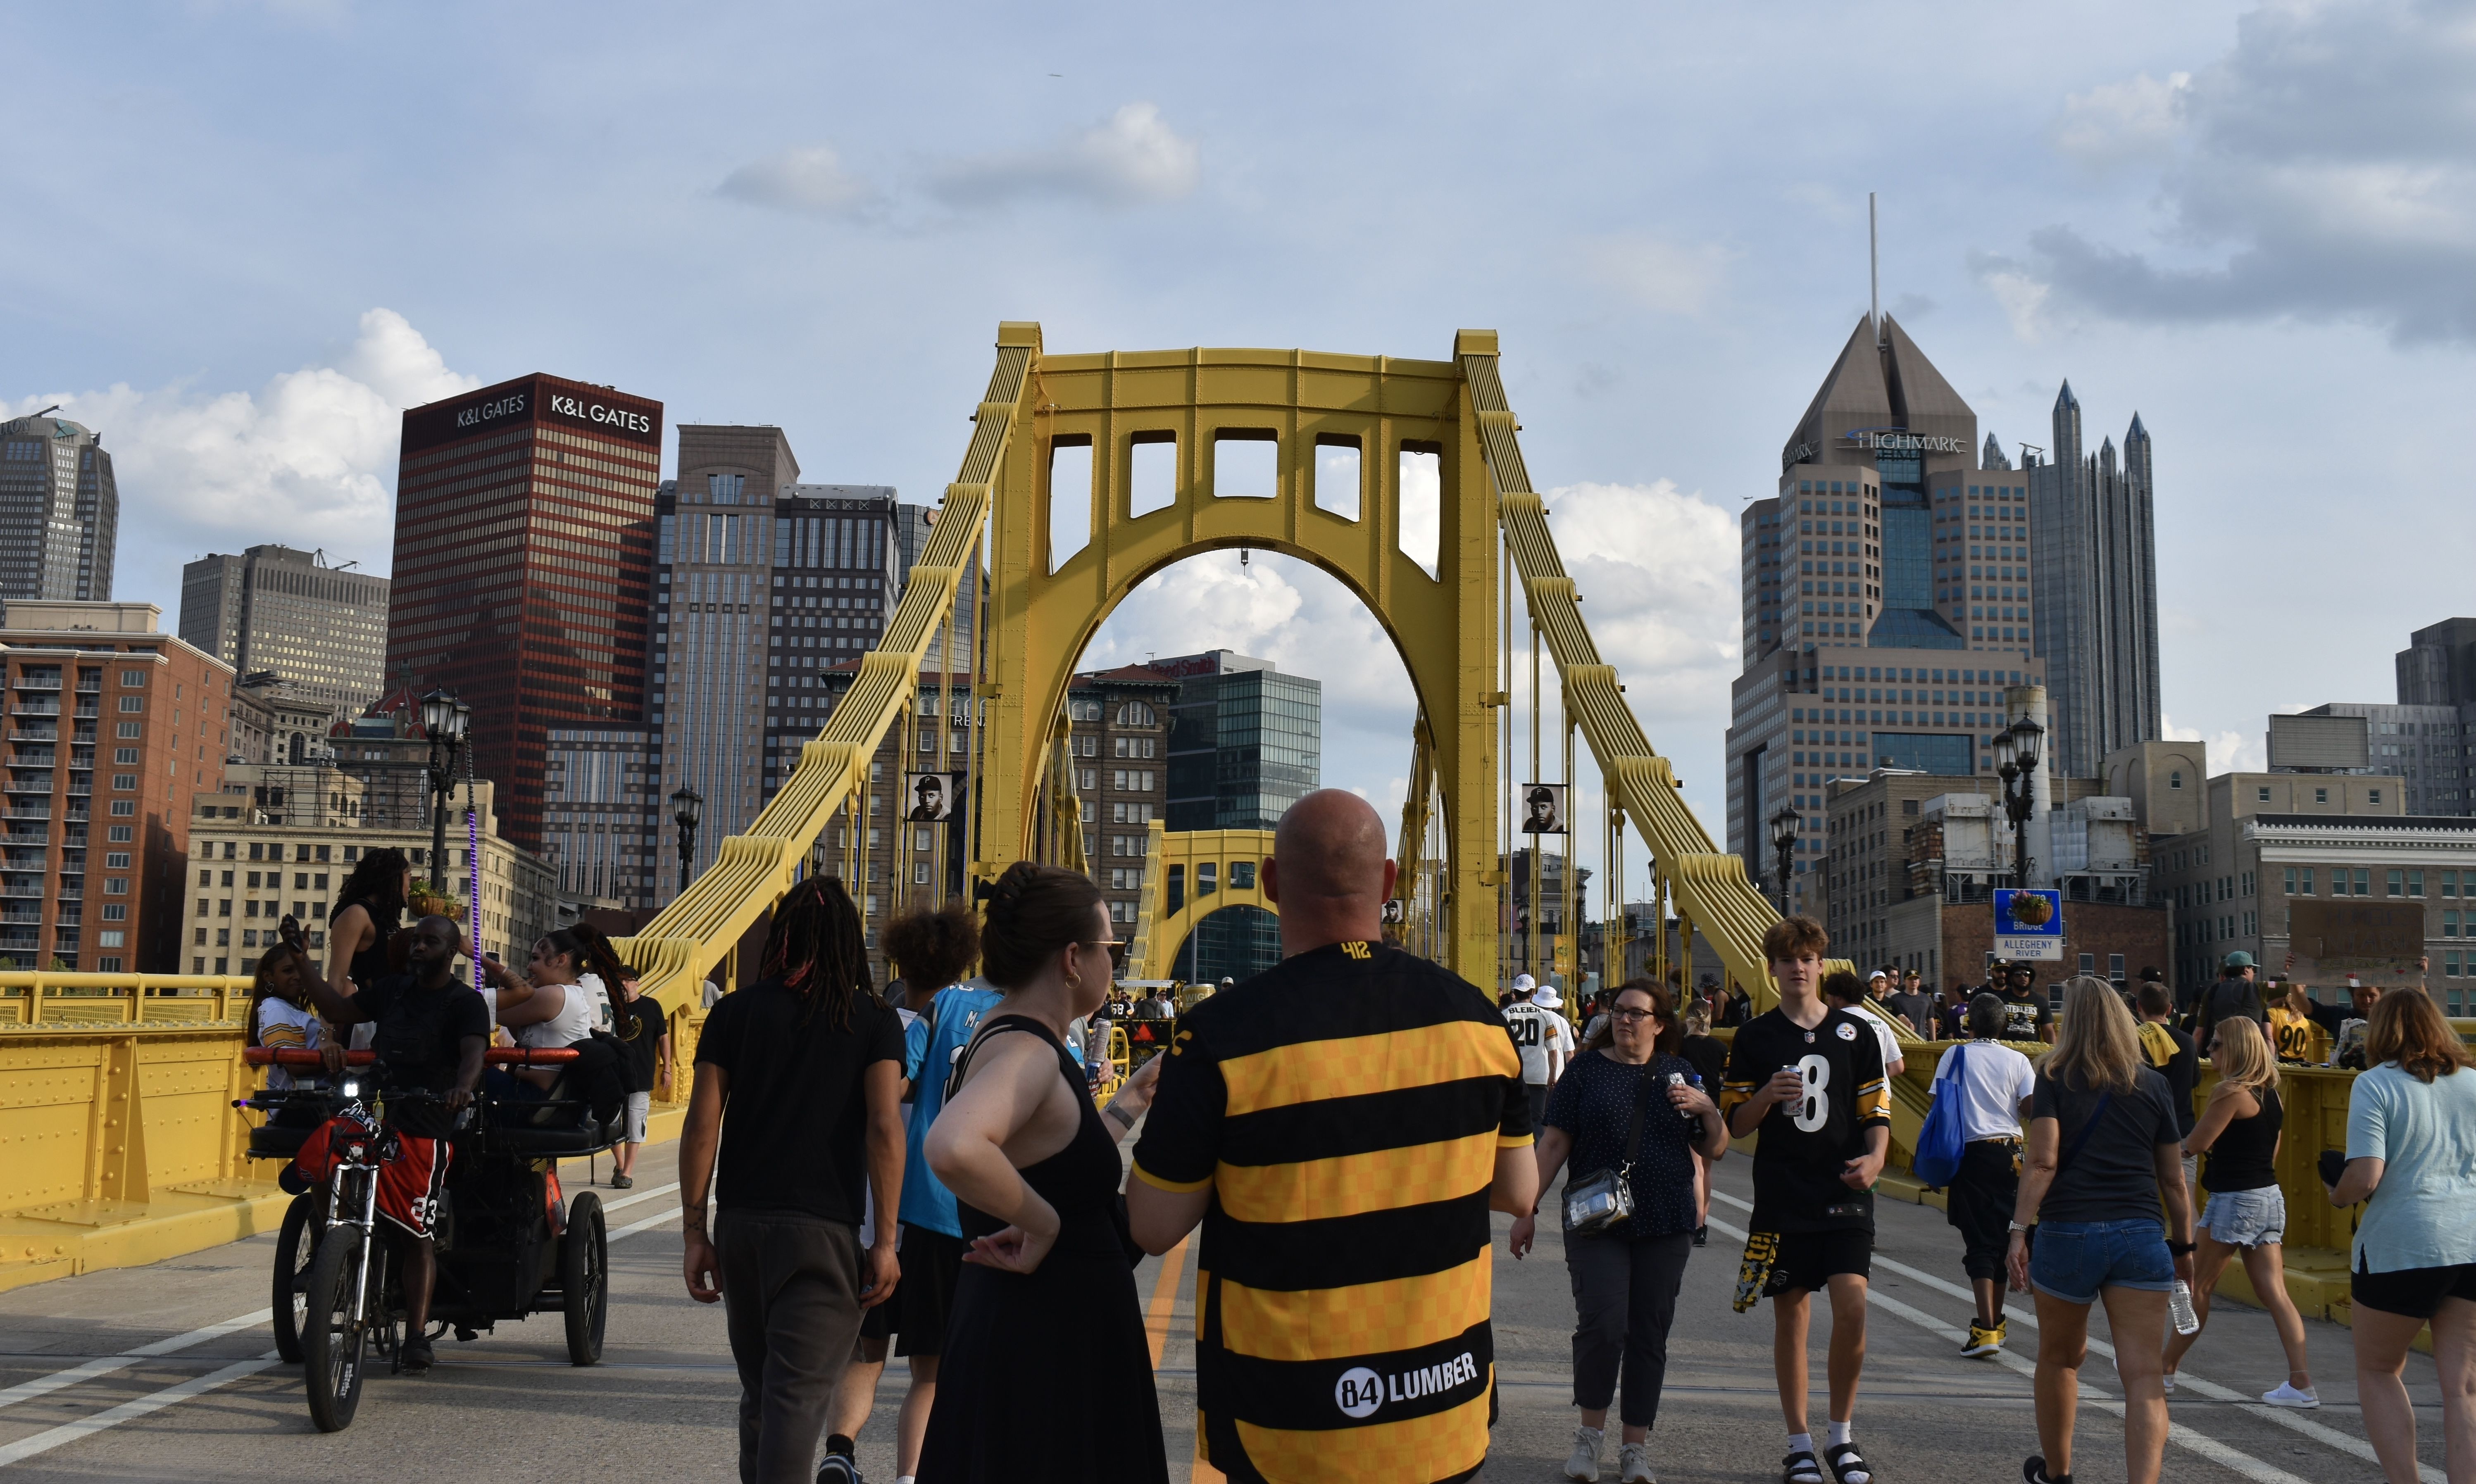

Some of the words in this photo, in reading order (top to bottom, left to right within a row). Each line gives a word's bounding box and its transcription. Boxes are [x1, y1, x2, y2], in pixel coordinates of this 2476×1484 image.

[457, 407, 480, 428] K&L
[483, 394, 524, 419] GATES
[552, 395, 586, 419] K&L
[590, 404, 649, 433] GATES
[1859, 432, 1960, 453] HIGHMARK
[1181, 657, 1216, 676] Smith
[1341, 941, 1371, 959] 412
[2004, 940, 2052, 949] ALLEGHENY
[2005, 1004, 2038, 1015] STEELERS
[1509, 1018, 1539, 1046] 20
[2279, 1025, 2306, 1054] 90
[1794, 1054, 1830, 1132] 8
[411, 1197, 437, 1225] 23
[1342, 1377, 1378, 1408] 84
[1389, 1352, 1477, 1402] LUMBER
